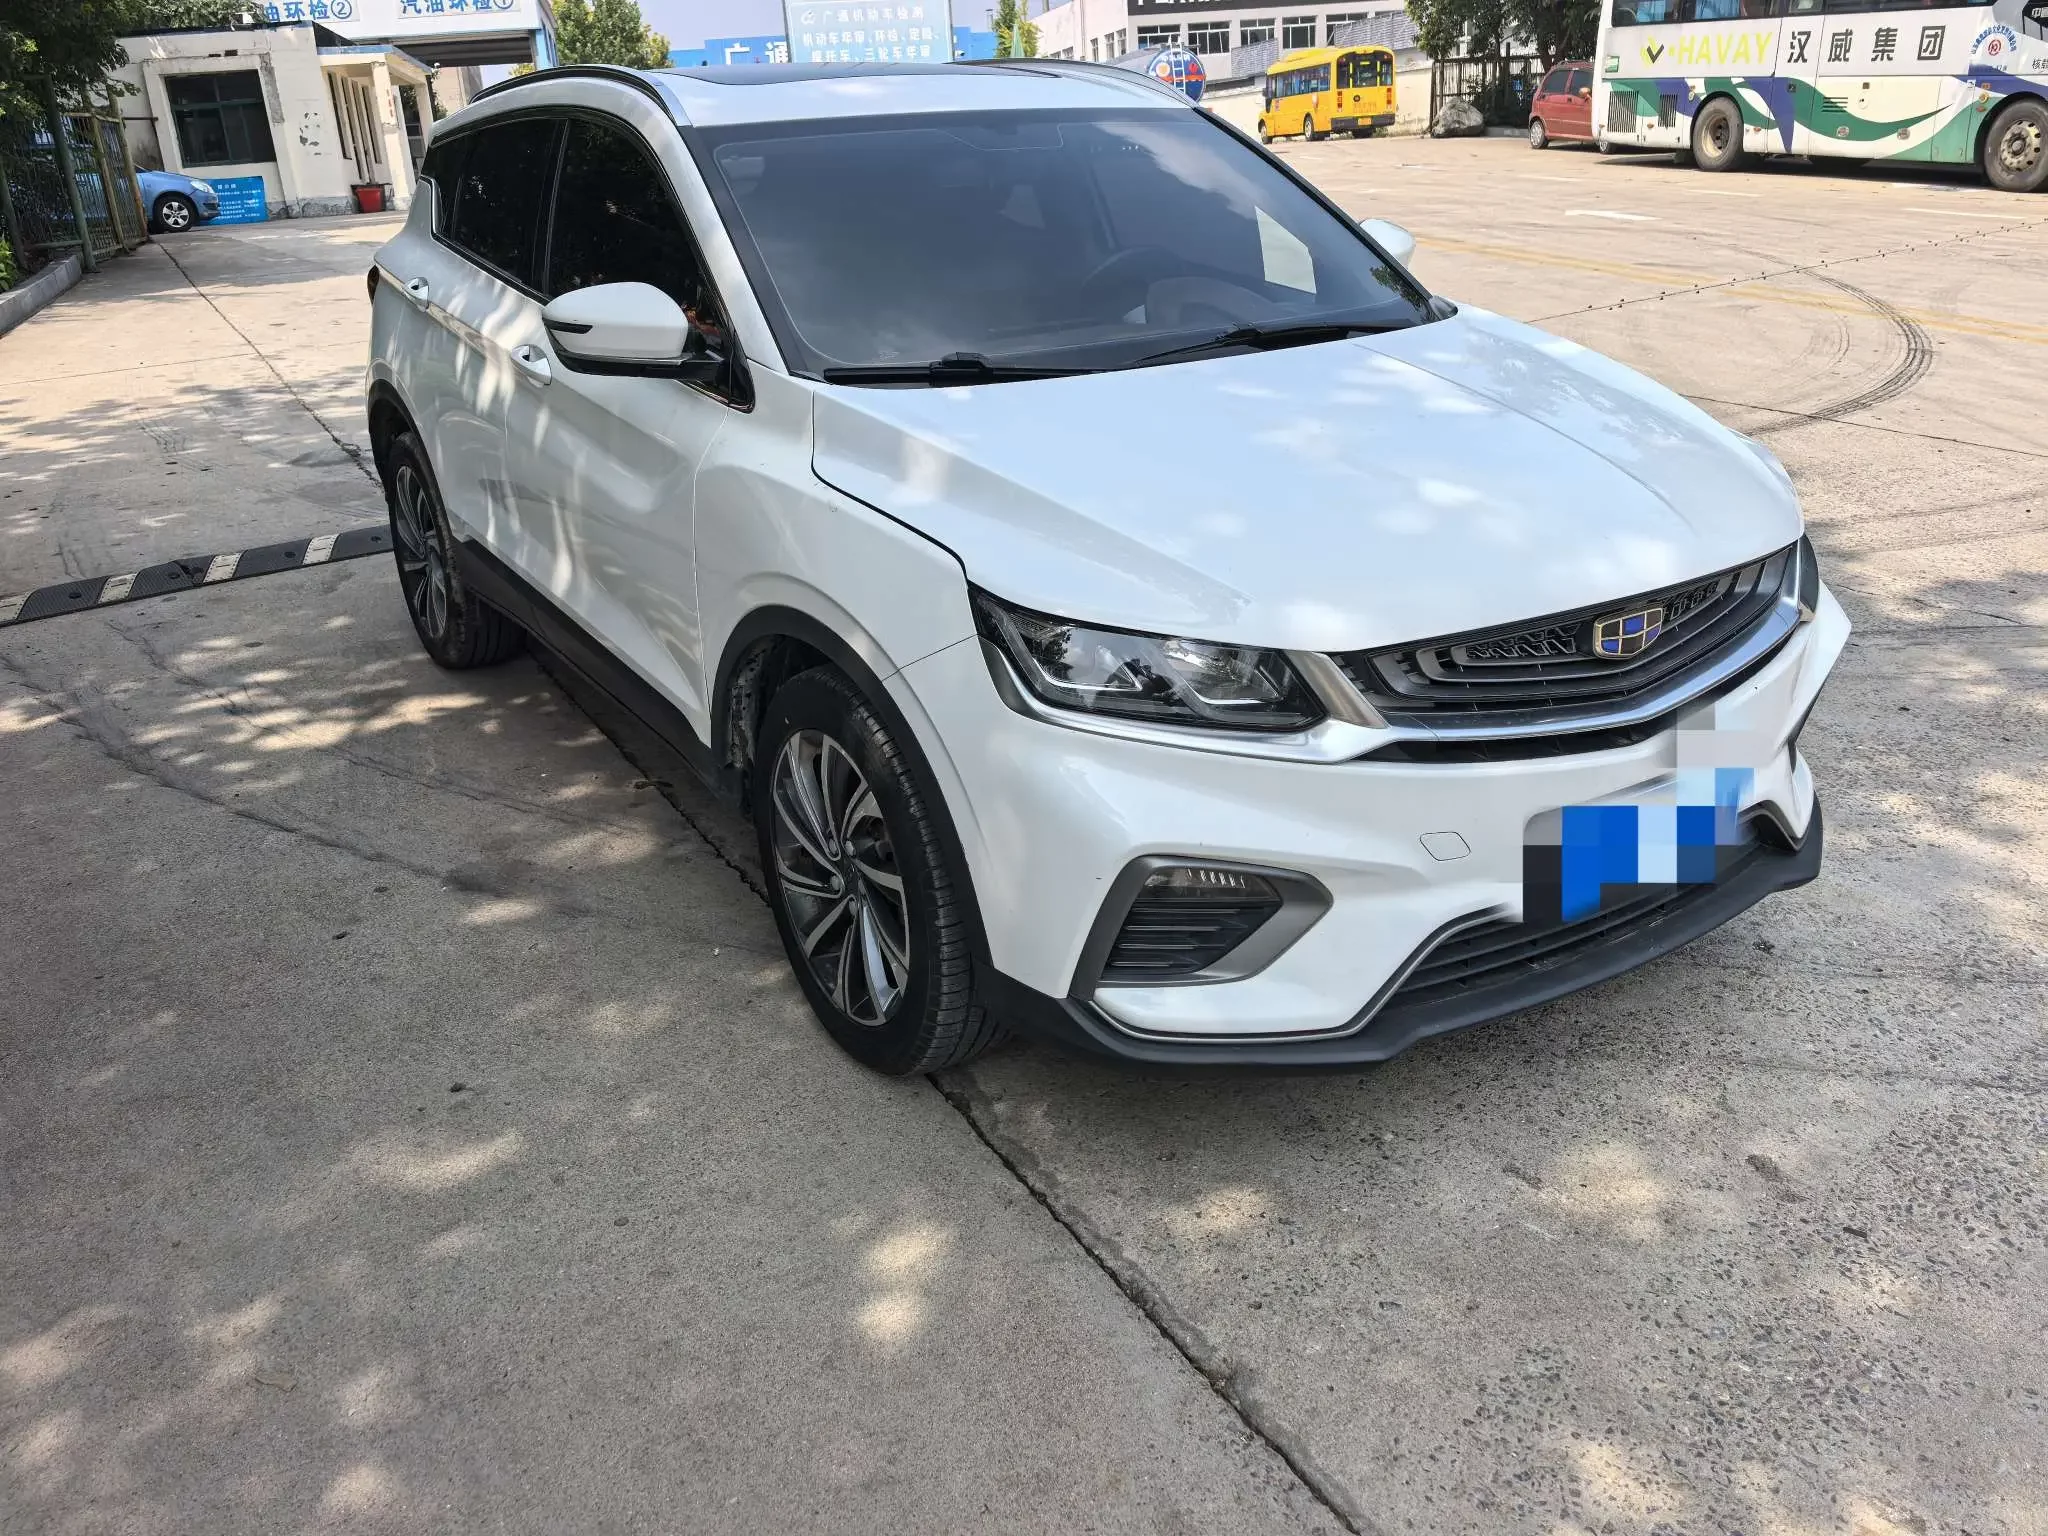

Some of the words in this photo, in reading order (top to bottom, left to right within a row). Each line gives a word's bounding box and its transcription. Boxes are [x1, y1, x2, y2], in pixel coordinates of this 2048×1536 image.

[1677, 32, 1773, 65] HAVAY
[1787, 25, 1946, 63] 汉威集团
